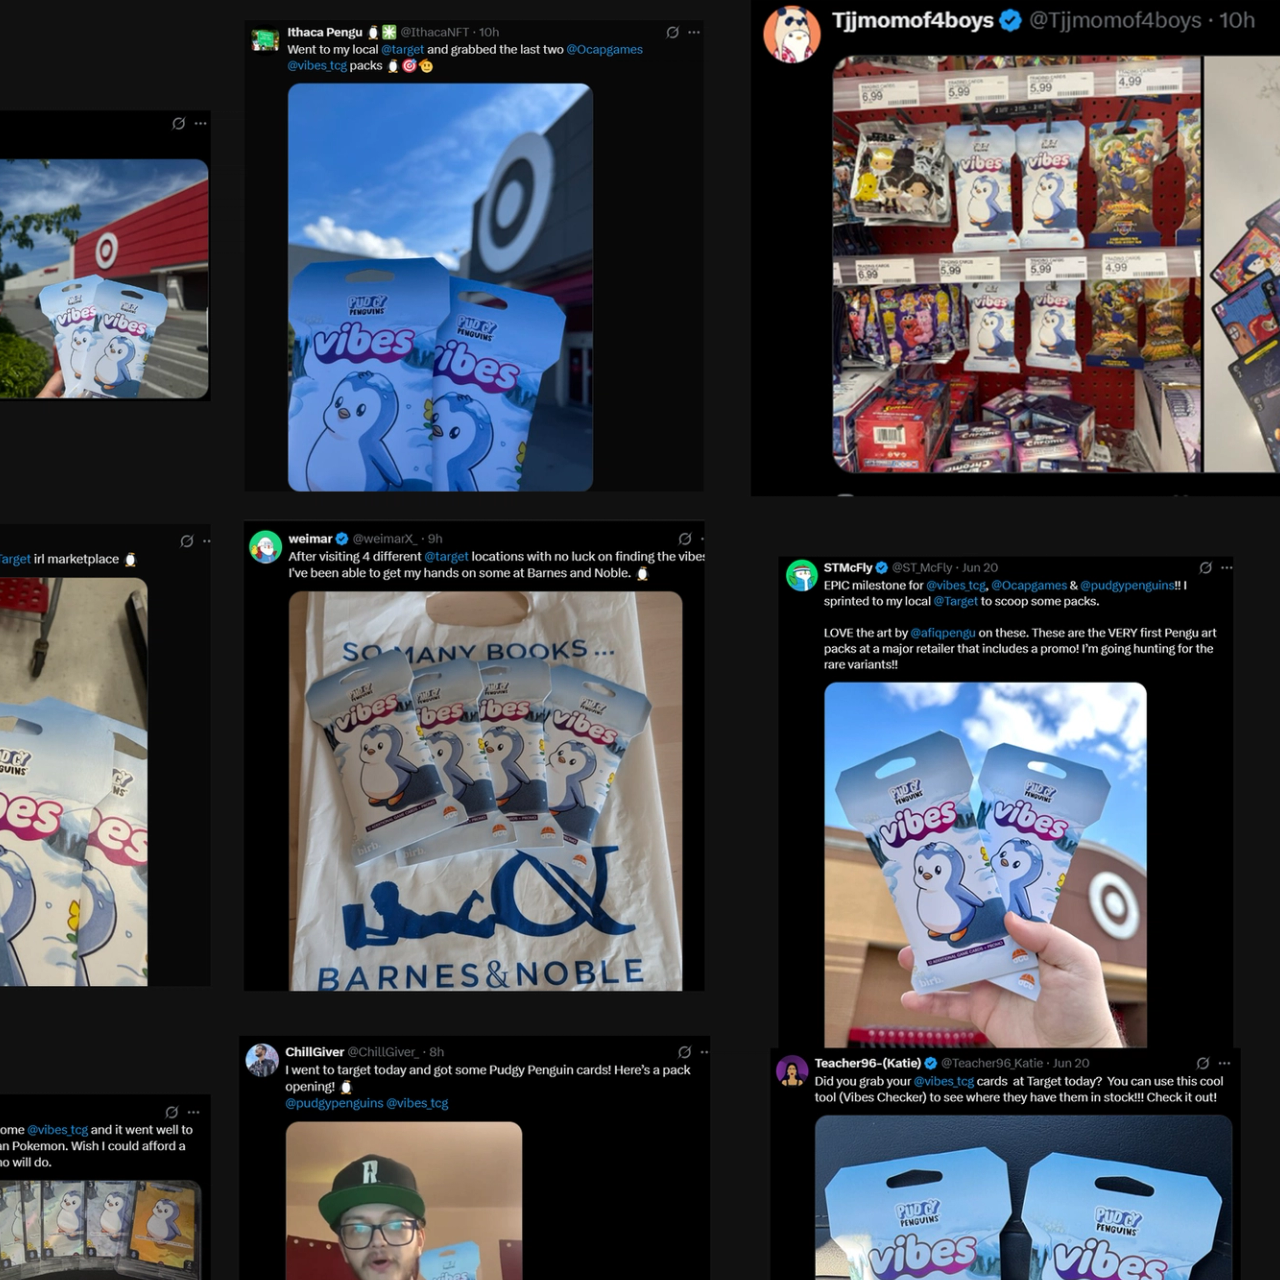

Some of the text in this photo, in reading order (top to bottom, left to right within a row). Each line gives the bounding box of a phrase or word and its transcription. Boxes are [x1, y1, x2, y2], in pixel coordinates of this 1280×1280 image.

[832, 11, 994, 32] Tjjmomof4boys
[288, 27, 362, 39] Ithaca Pengu
[961, 156, 1003, 173] vibes
[313, 321, 416, 364] vibes
[289, 534, 332, 543] weimar
[824, 563, 873, 574] STMcFly
[487, 639, 587, 663] BOOKS
[848, 659, 897, 669] variants!!
[336, 694, 398, 733] vibes
[286, 1047, 344, 1056] ChillGiver
[815, 1058, 921, 1069] Teacher96-(Katie)
